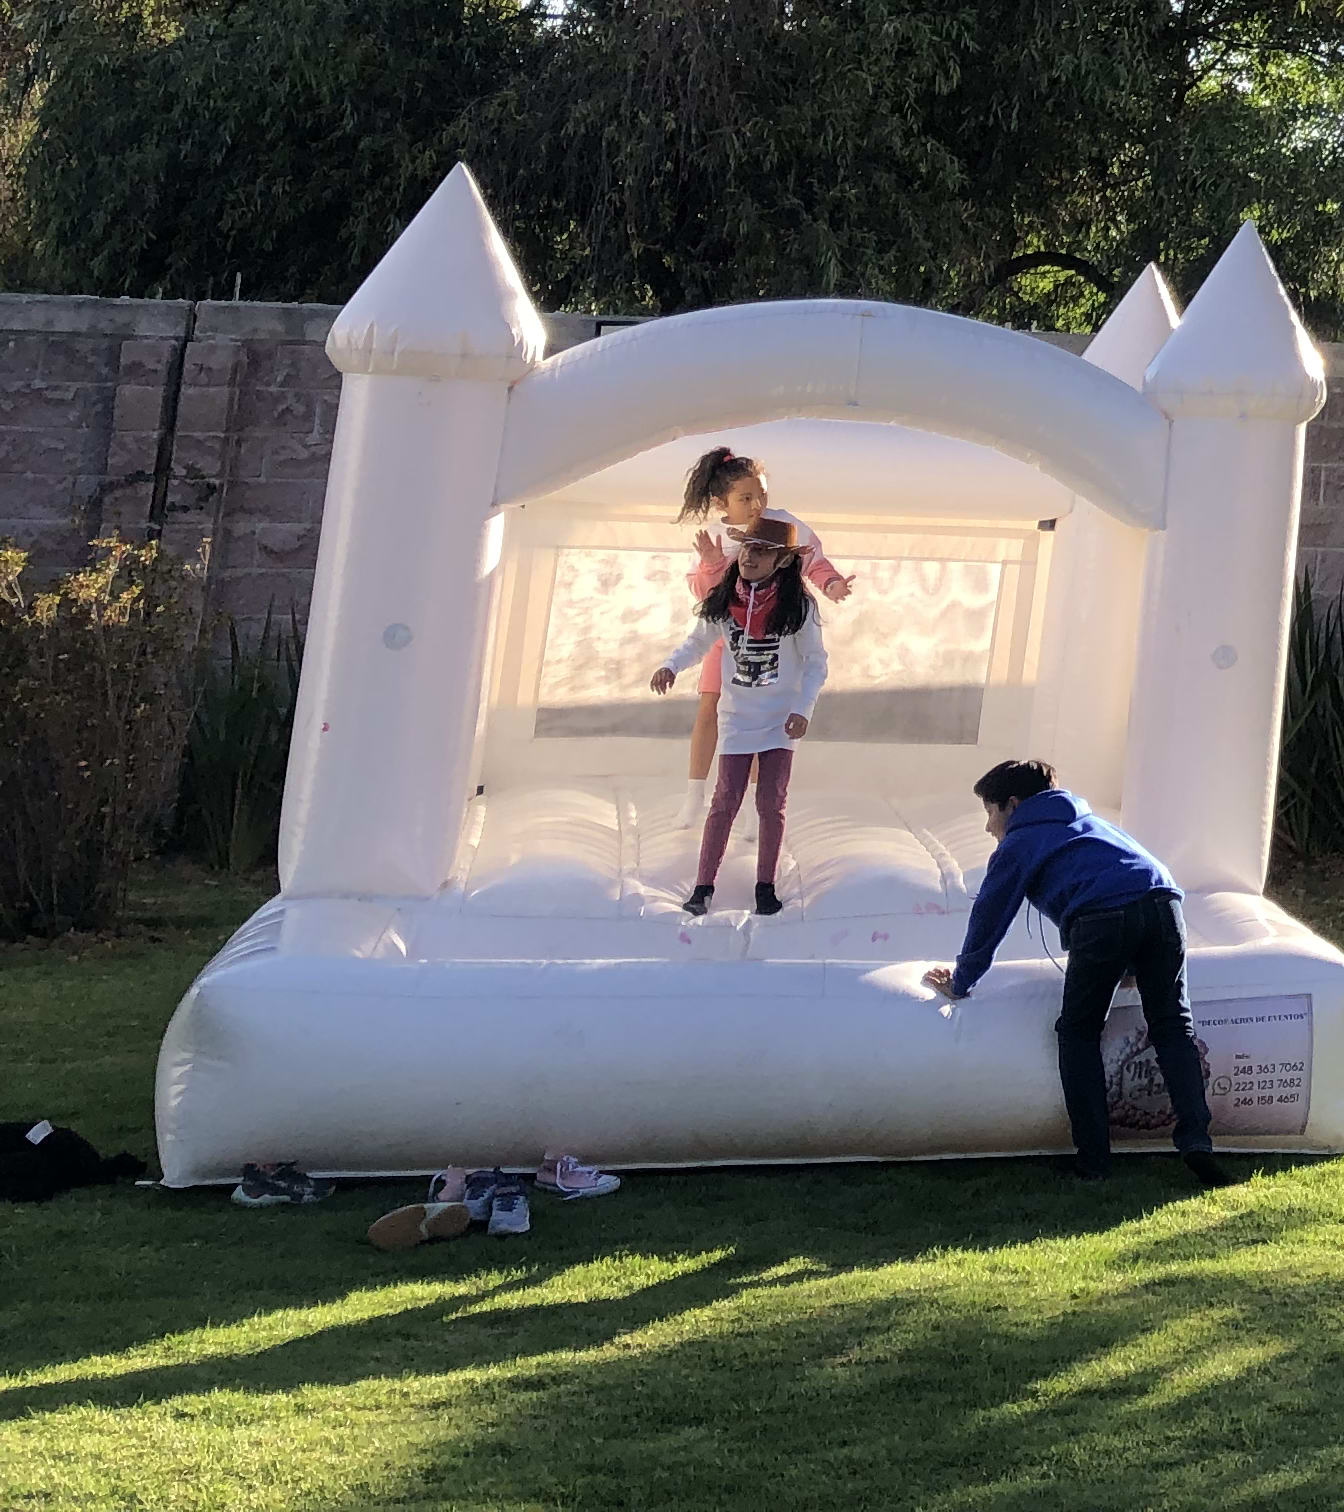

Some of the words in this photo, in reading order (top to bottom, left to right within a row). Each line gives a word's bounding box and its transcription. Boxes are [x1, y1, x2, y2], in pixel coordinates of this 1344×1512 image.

[1233, 1065, 1253, 1076] 248
[1256, 1063, 1276, 1075] 363
[1278, 1061, 1305, 1073] 7062
[1234, 1081, 1254, 1092] 222
[1257, 1079, 1274, 1090] 123
[1276, 1077, 1302, 1088] 7682
[1276, 1093, 1300, 1104] 4651
